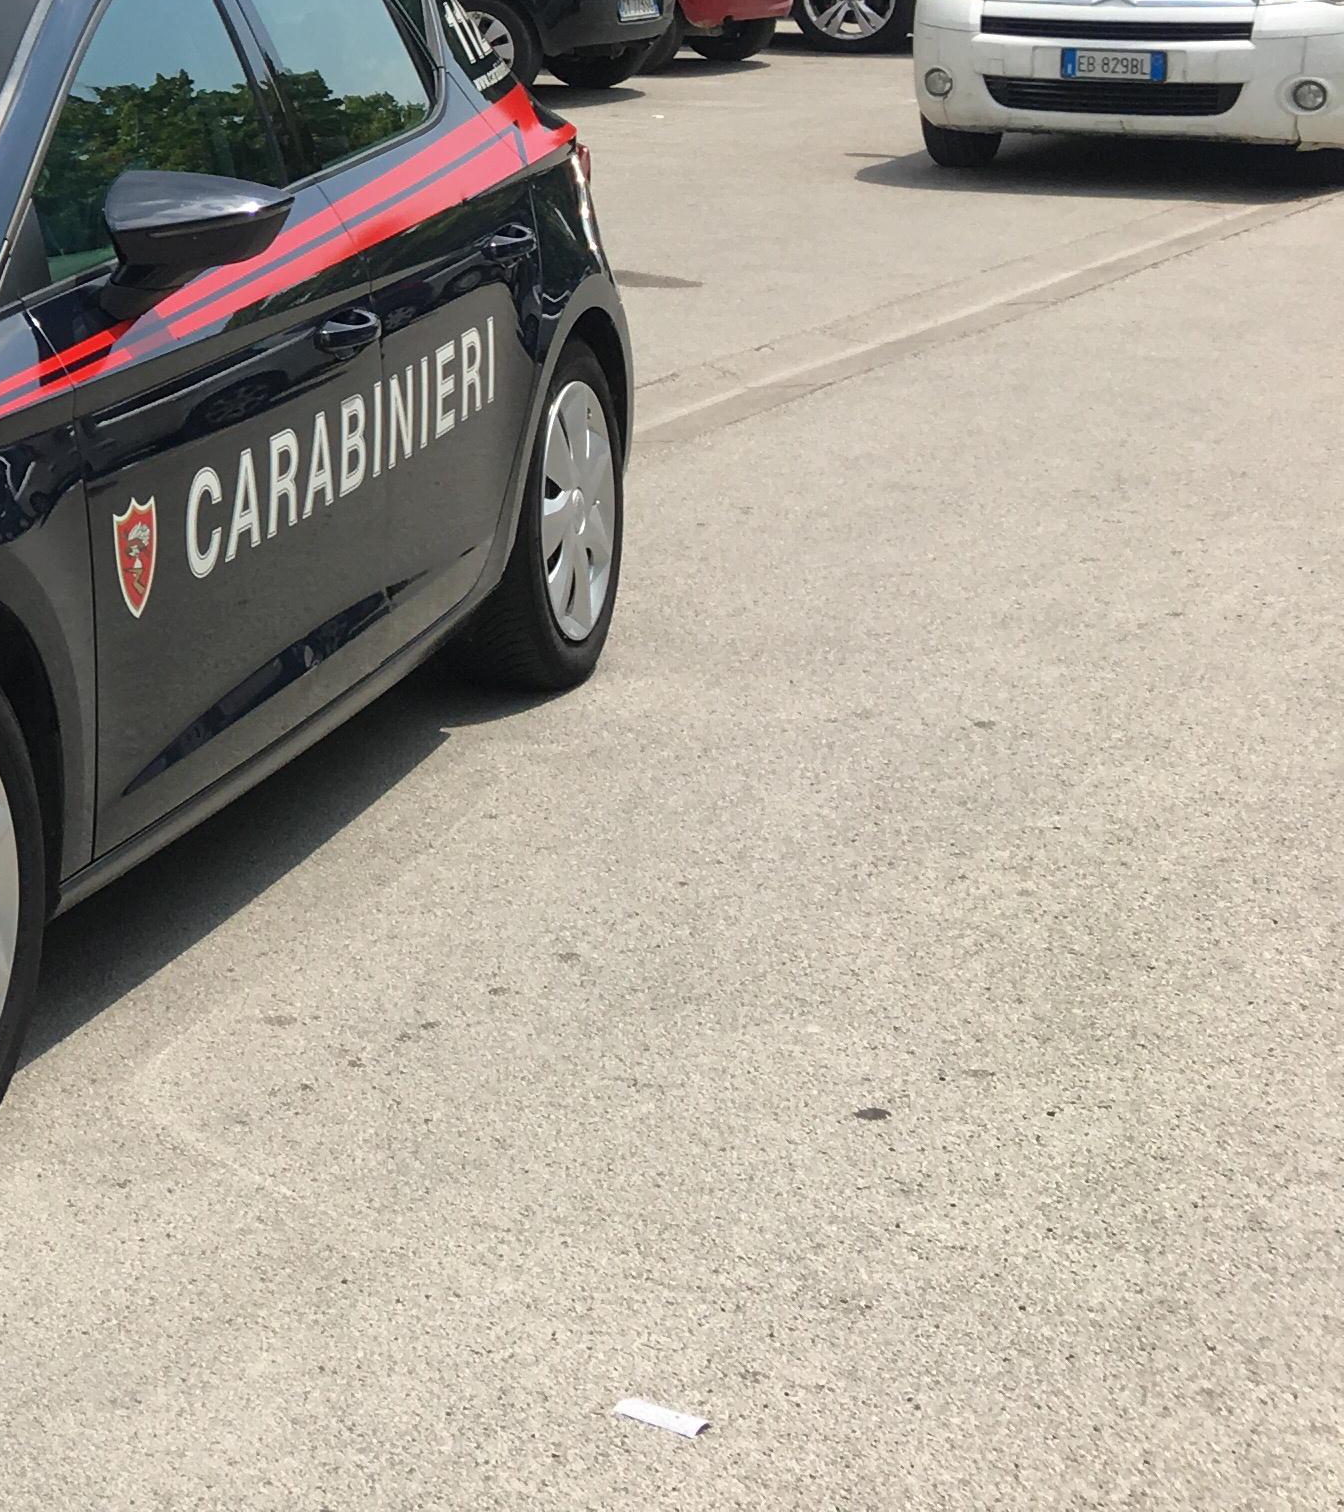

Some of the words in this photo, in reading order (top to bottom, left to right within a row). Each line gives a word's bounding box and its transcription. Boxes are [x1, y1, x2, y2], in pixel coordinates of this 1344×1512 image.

[1077, 54, 1096, 74] EB
[1100, 56, 1151, 76] 829BL
[185, 315, 495, 580] CARABINIERI
